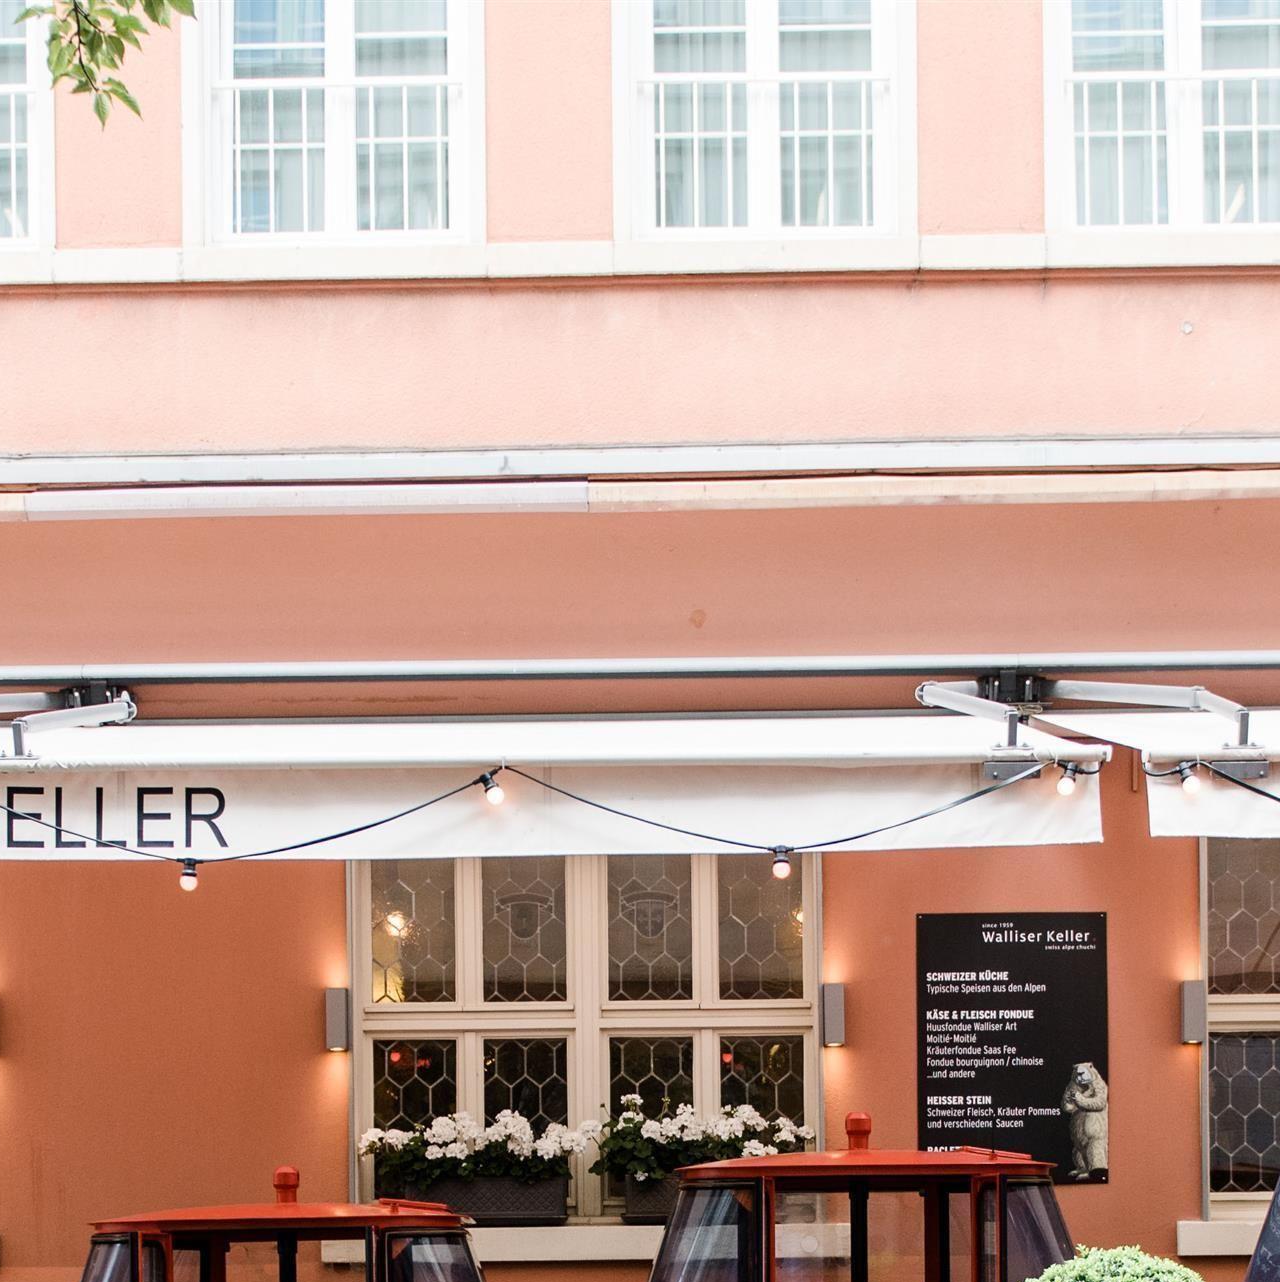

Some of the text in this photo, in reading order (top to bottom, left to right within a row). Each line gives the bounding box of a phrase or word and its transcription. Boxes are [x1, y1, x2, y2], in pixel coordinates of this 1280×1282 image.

[982, 929, 1090, 943] Walliser Keller
[926, 969, 1009, 982] SCHWEIZER KÜCHE
[926, 984, 959, 994] Typische
[961, 983, 991, 994] Speisen
[1008, 983, 1023, 992] den
[1024, 983, 1046, 994] Alpen
[926, 1009, 949, 1020] KÄSE
[961, 1010, 996, 1020] FLEISCH
[999, 1009, 1034, 1019] FONDUE
[927, 1021, 1017, 1032] Huusfondue Walliser Art
[927, 1045, 1016, 1055] Kräuterfondue Saas Fee
[927, 1057, 954, 1067] Fondue
[956, 1057, 1005, 1068] bourguignon
[1012, 1056, 1044, 1066] chinoise
[949, 1069, 976, 1078] andere
[927, 1096, 992, 1105] HEISSER STEIN
[927, 1107, 965, 1117] Schweizer
[997, 1106, 1026, 1116] Kräuter
[1028, 1106, 1061, 1116] Pommes
[927, 1119, 941, 1128] und
[996, 1119, 1024, 1128] Saucen
